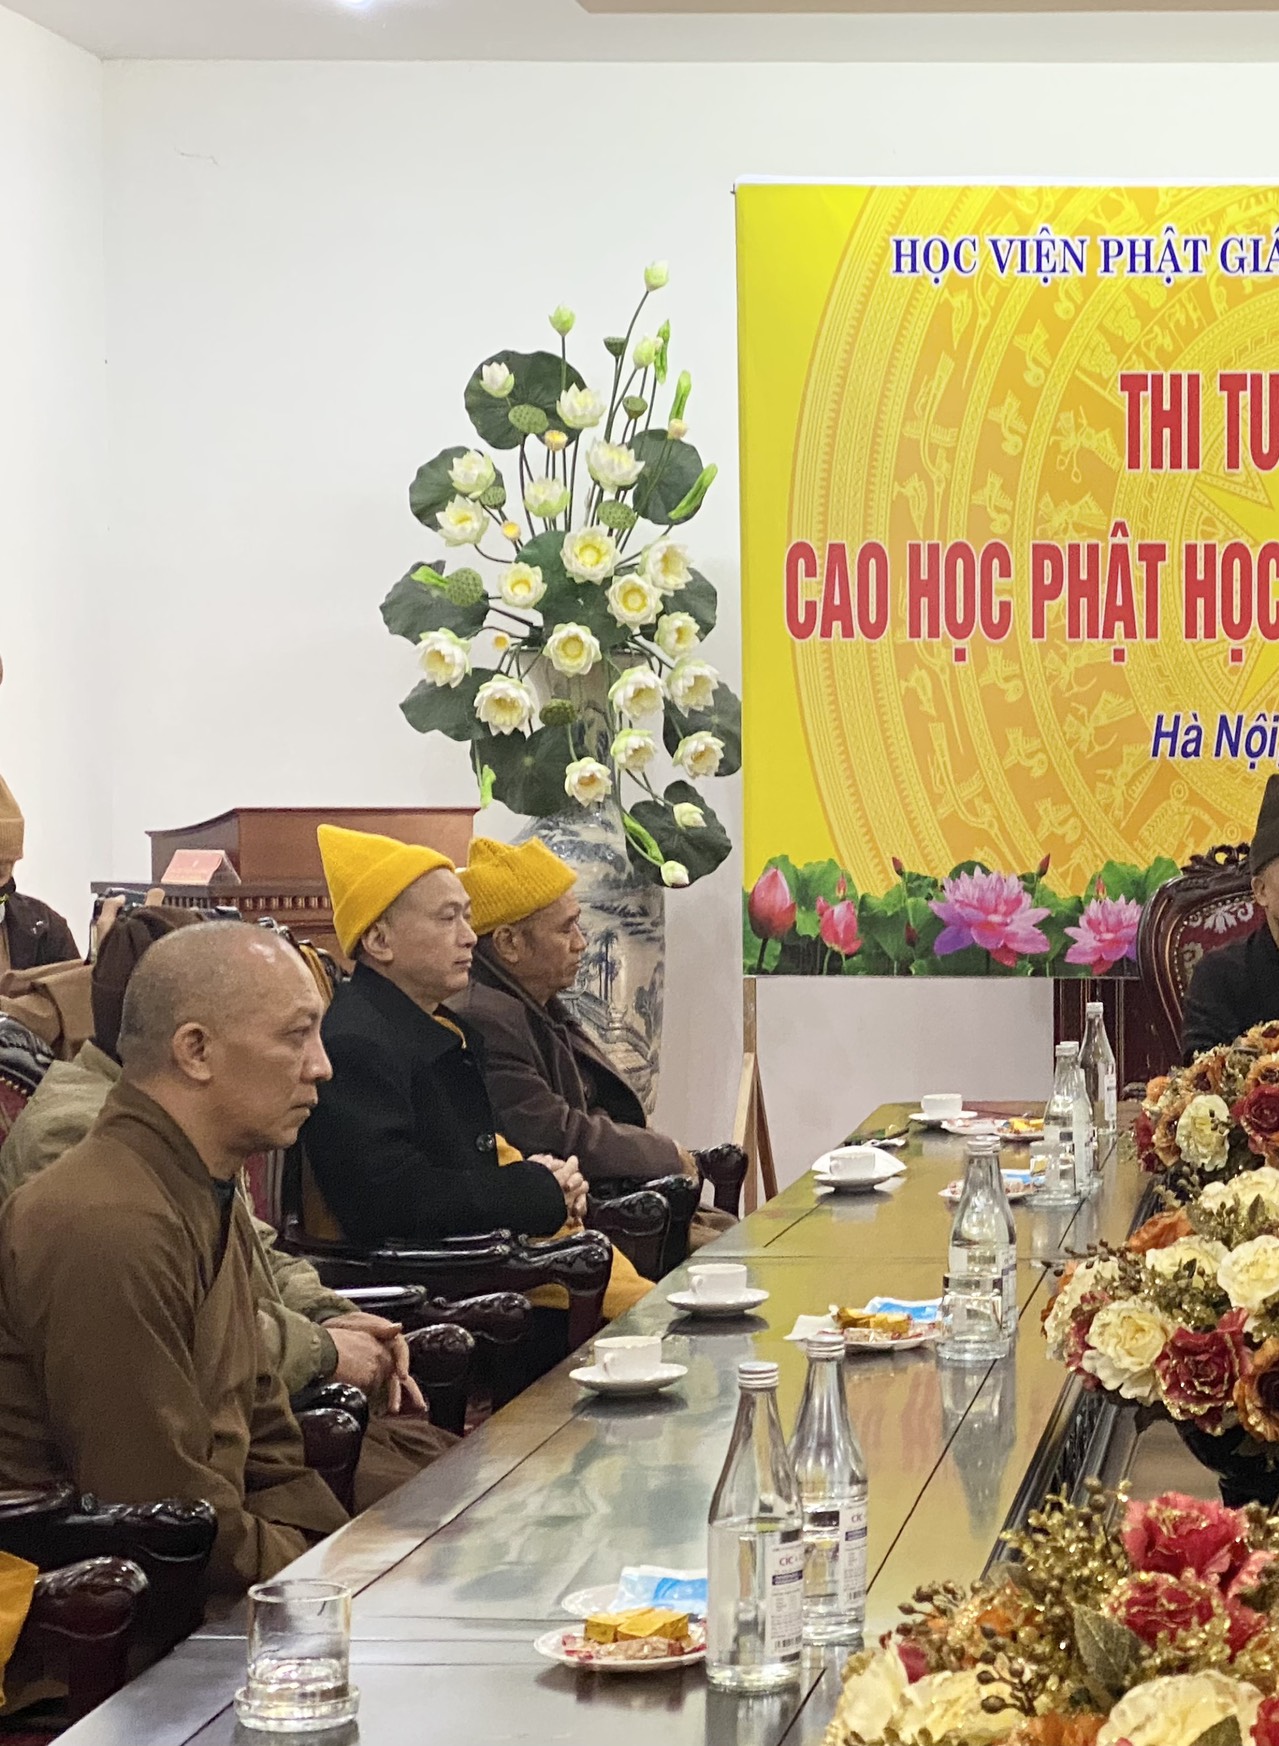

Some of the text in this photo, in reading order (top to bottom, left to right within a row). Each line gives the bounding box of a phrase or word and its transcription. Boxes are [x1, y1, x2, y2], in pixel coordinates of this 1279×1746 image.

[892, 237, 977, 284] HỌC
[989, 226, 1085, 284] VIỆN
[1100, 226, 1208, 284] PHẬT
[1120, 372, 1200, 470] THI
[786, 541, 888, 640] CAO
[908, 541, 1012, 662] HỌC
[1032, 521, 1166, 663] PHẬT
[1151, 713, 1202, 758] Hà
